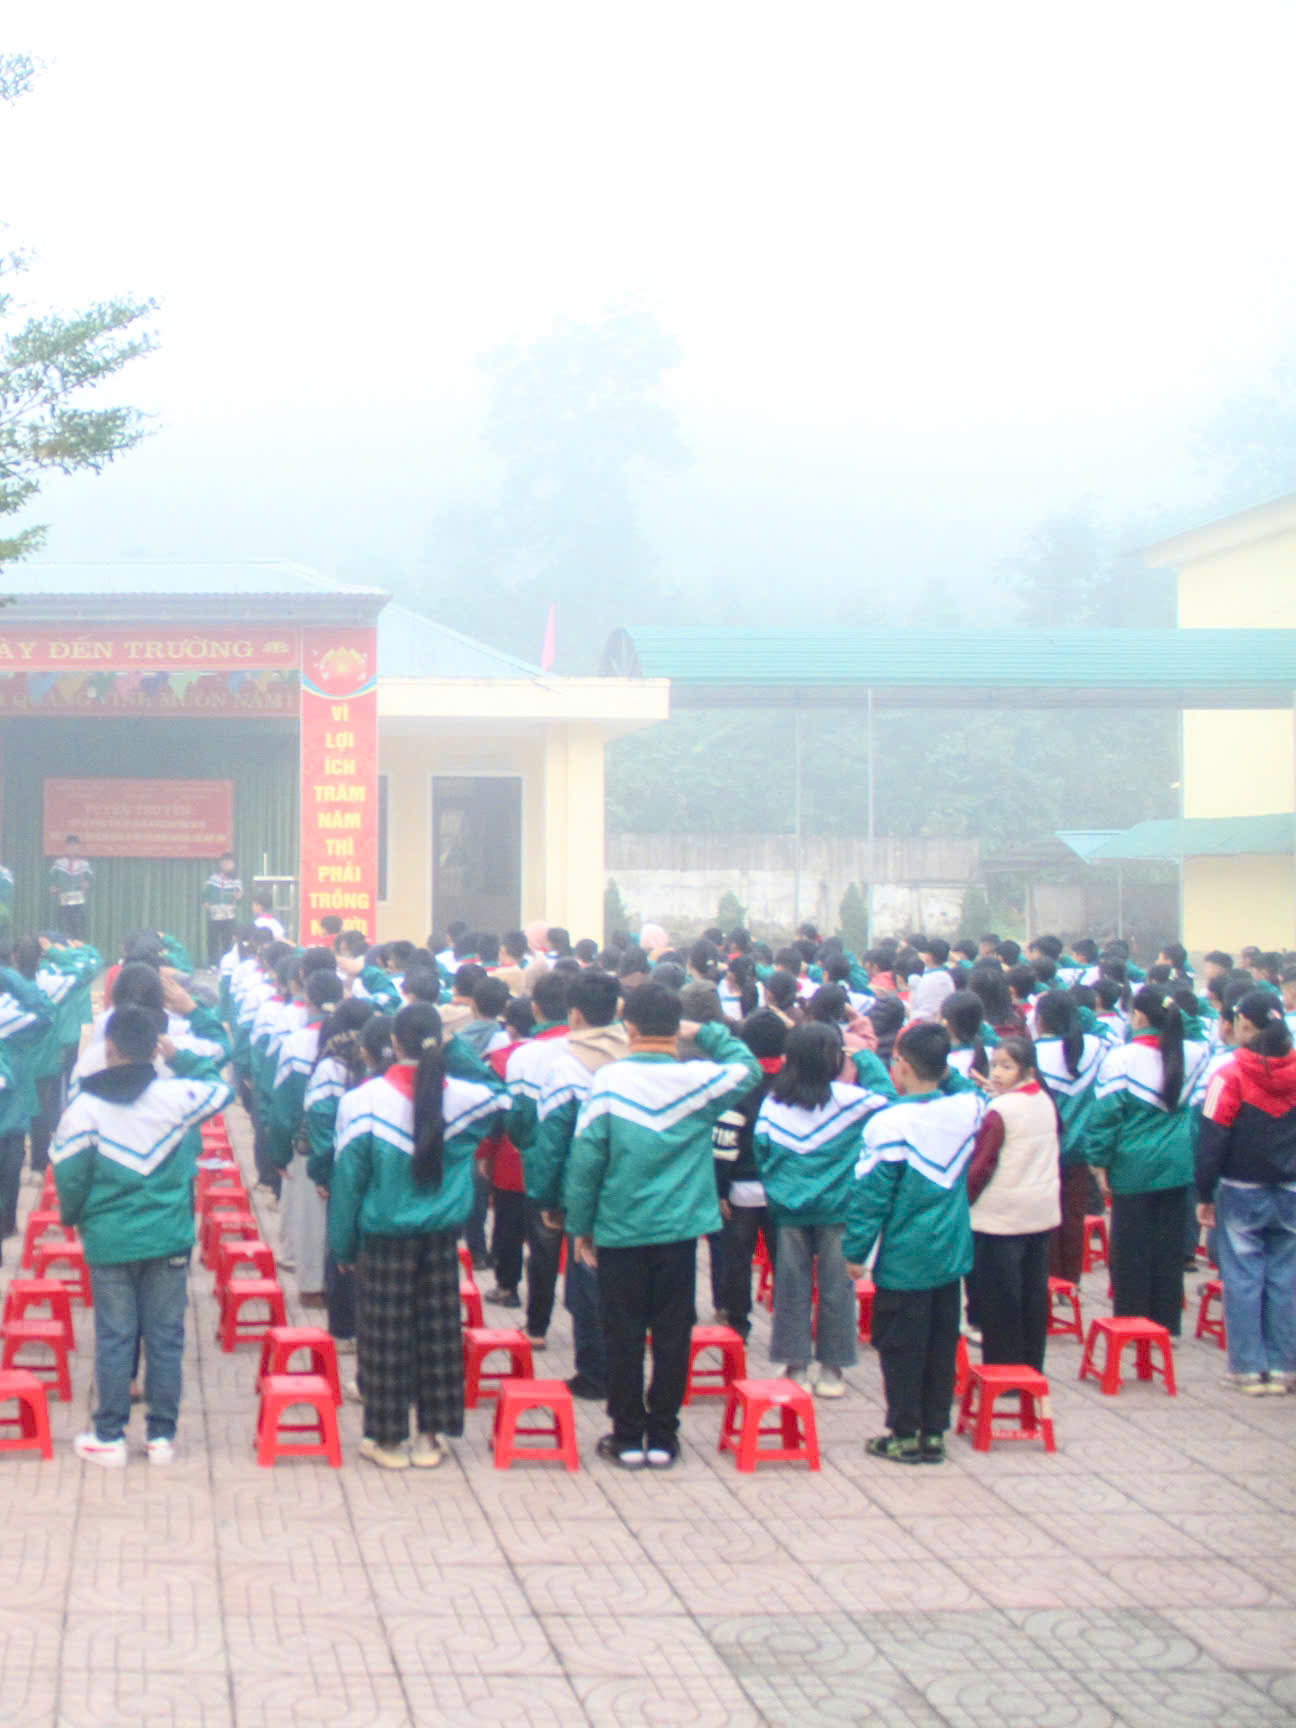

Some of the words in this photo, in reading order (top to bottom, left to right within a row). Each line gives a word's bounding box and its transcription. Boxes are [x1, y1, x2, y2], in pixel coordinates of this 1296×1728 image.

[48, 633, 114, 659] ĐẾN
[124, 634, 254, 660] TRƯỜNG
[331, 703, 350, 722] VÌ
[325, 731, 355, 753] LỢI
[325, 755, 357, 776] ÍCH
[313, 782, 367, 803] TRĂM
[317, 809, 362, 829] NĂM
[325, 836, 354, 857] THÌ
[317, 861, 362, 883] PHẢI
[308, 887, 369, 910] TRỒNG
